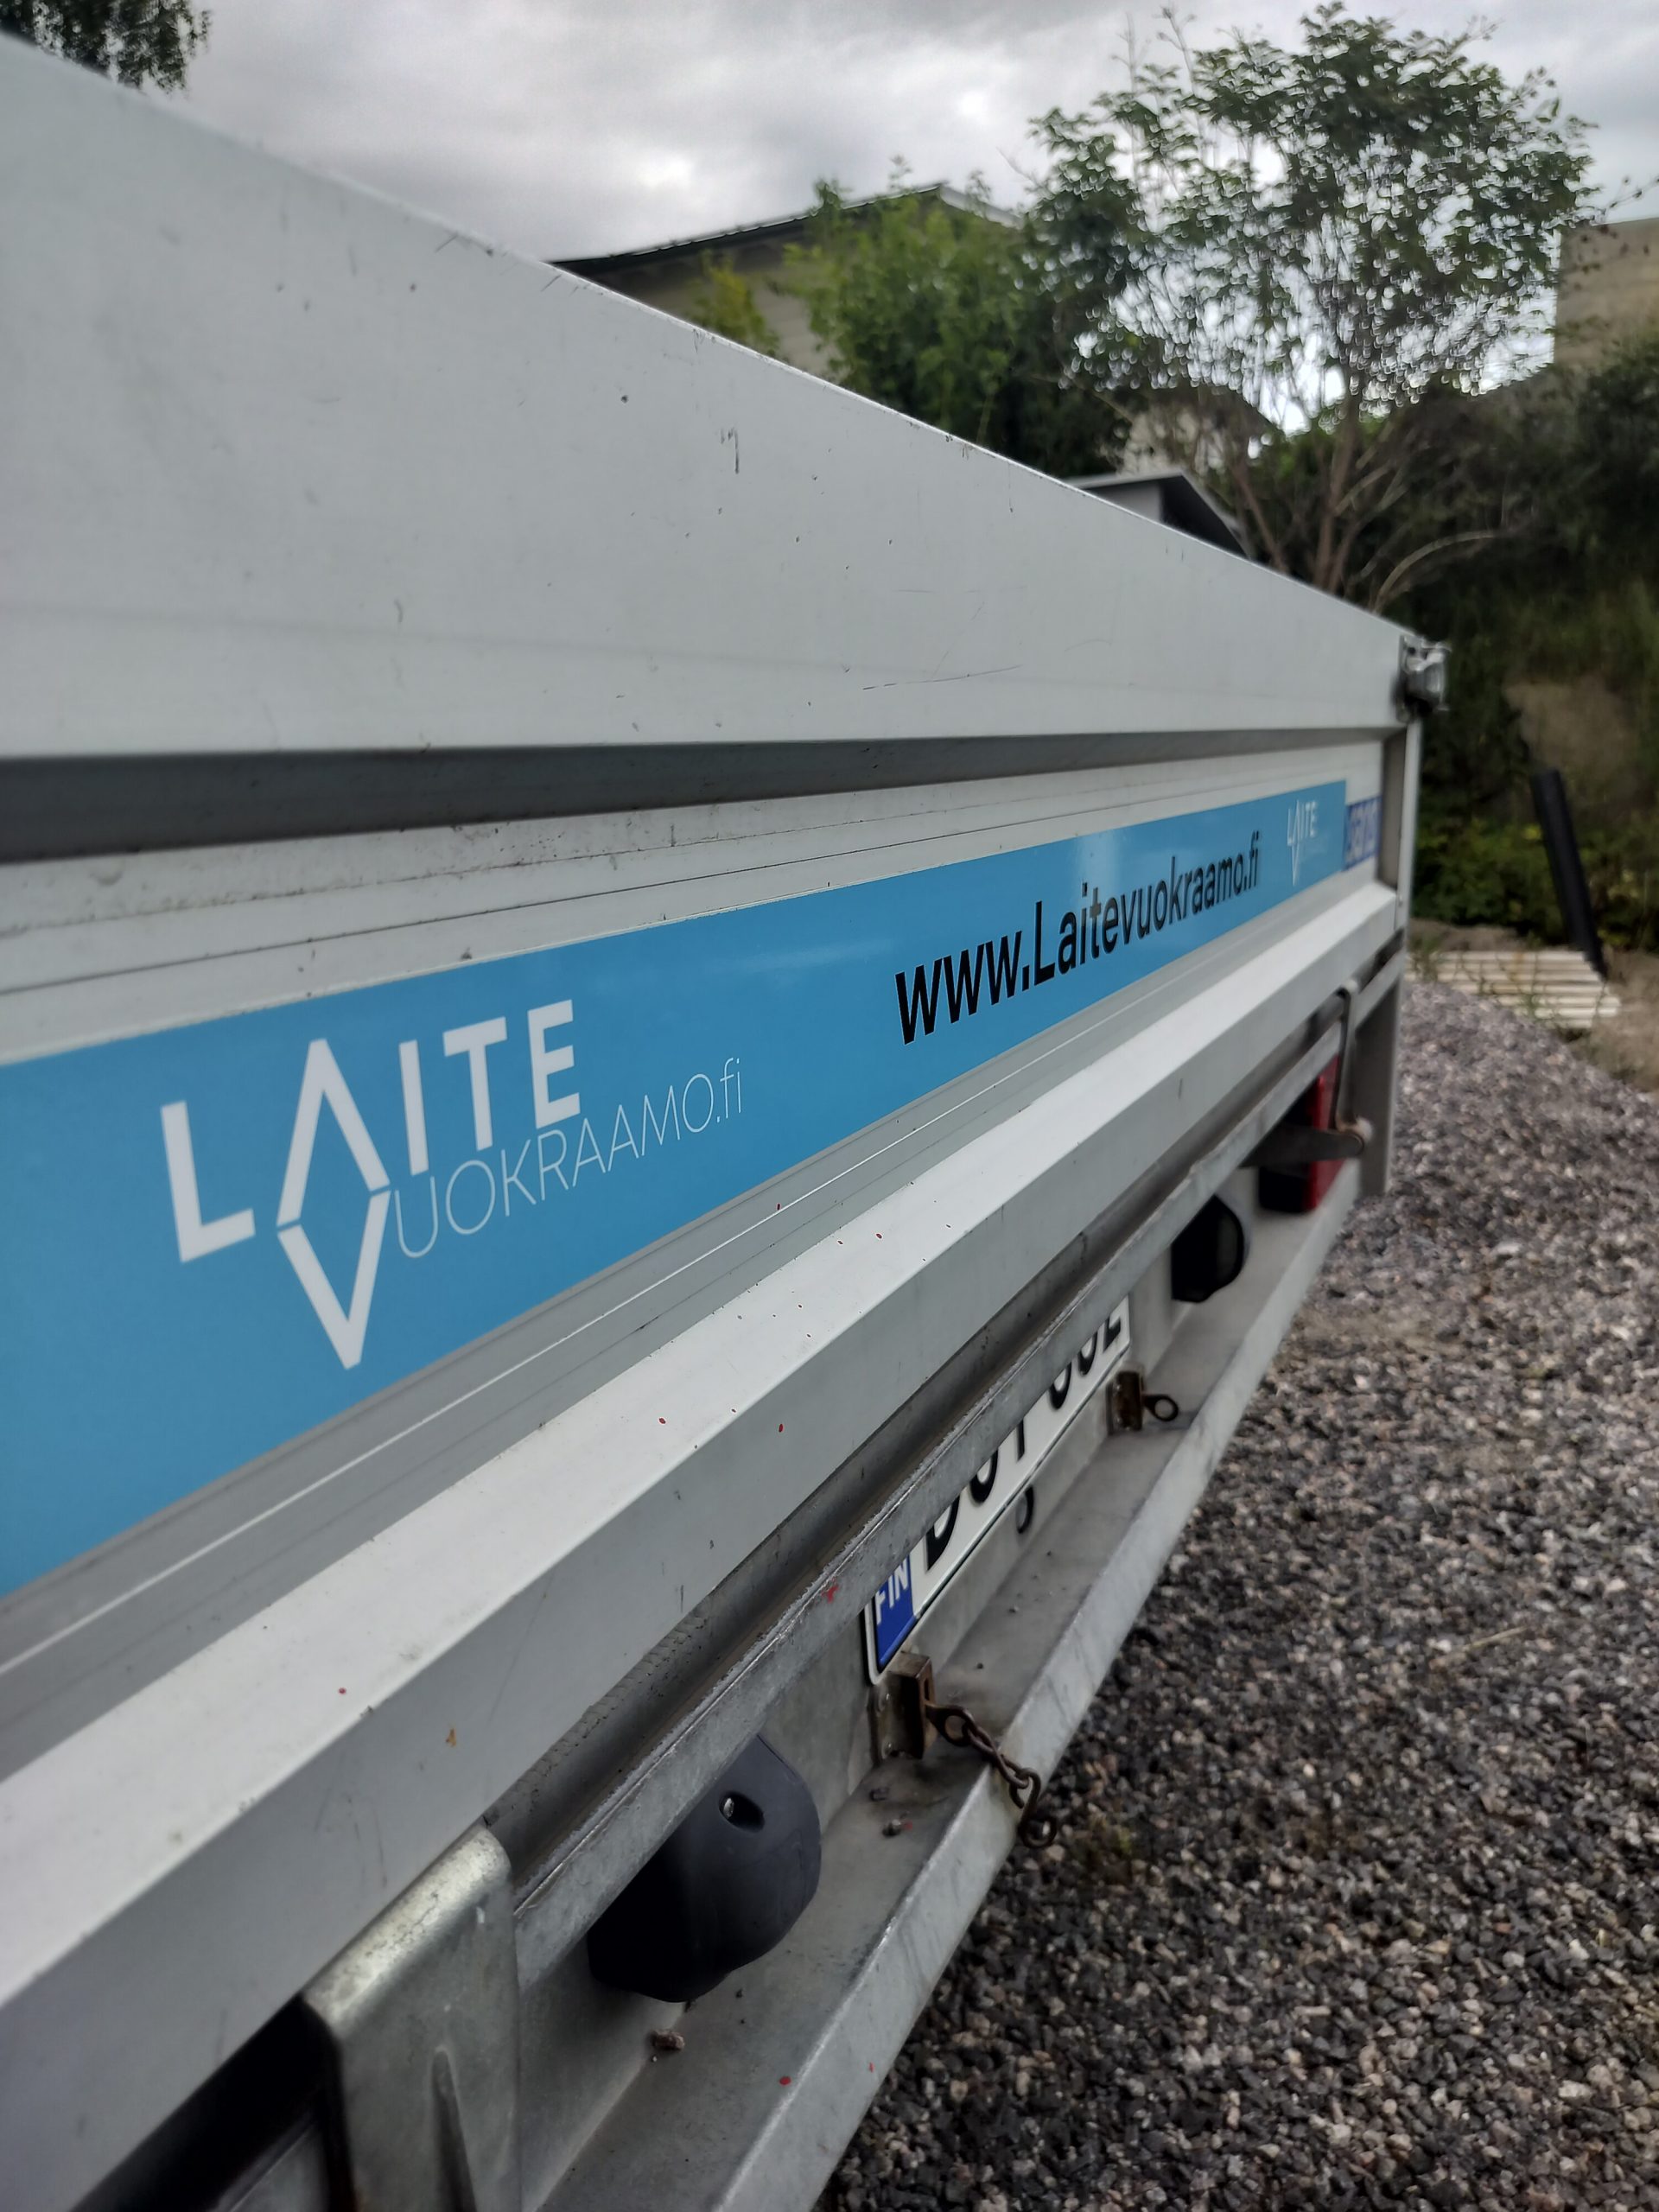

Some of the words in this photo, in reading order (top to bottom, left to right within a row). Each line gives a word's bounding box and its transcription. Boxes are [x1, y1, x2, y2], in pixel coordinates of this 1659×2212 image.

[895, 830, 1260, 1046] www.Laitevuokraamo.fi
[161, 999, 581, 1263] LAITE
[875, 1556, 908, 1625] FIN
